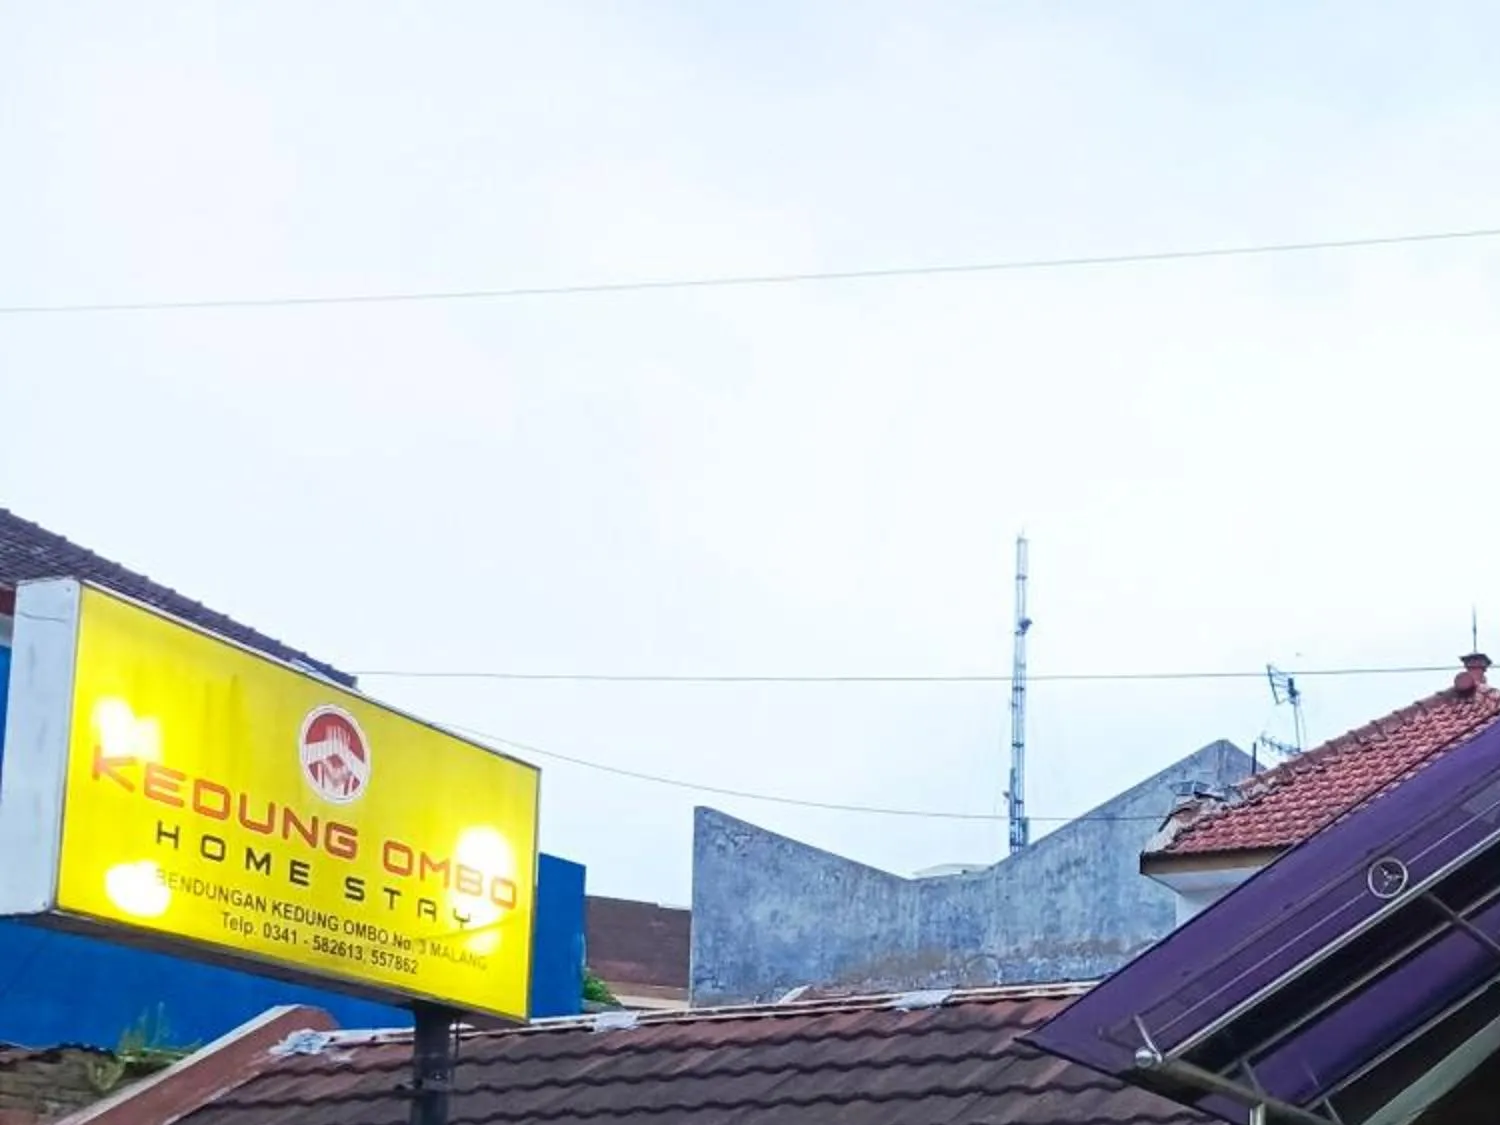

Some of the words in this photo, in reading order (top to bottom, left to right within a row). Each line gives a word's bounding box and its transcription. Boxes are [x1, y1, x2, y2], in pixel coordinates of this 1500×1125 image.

[91, 745, 358, 860] KEDUNG
[383, 840, 517, 909] OMBO
[264, 923, 296, 944] 0341
[272, 900, 338, 931] KEDUNG
[344, 920, 388, 944] OMBO
[431, 943, 488, 970] MALANG
